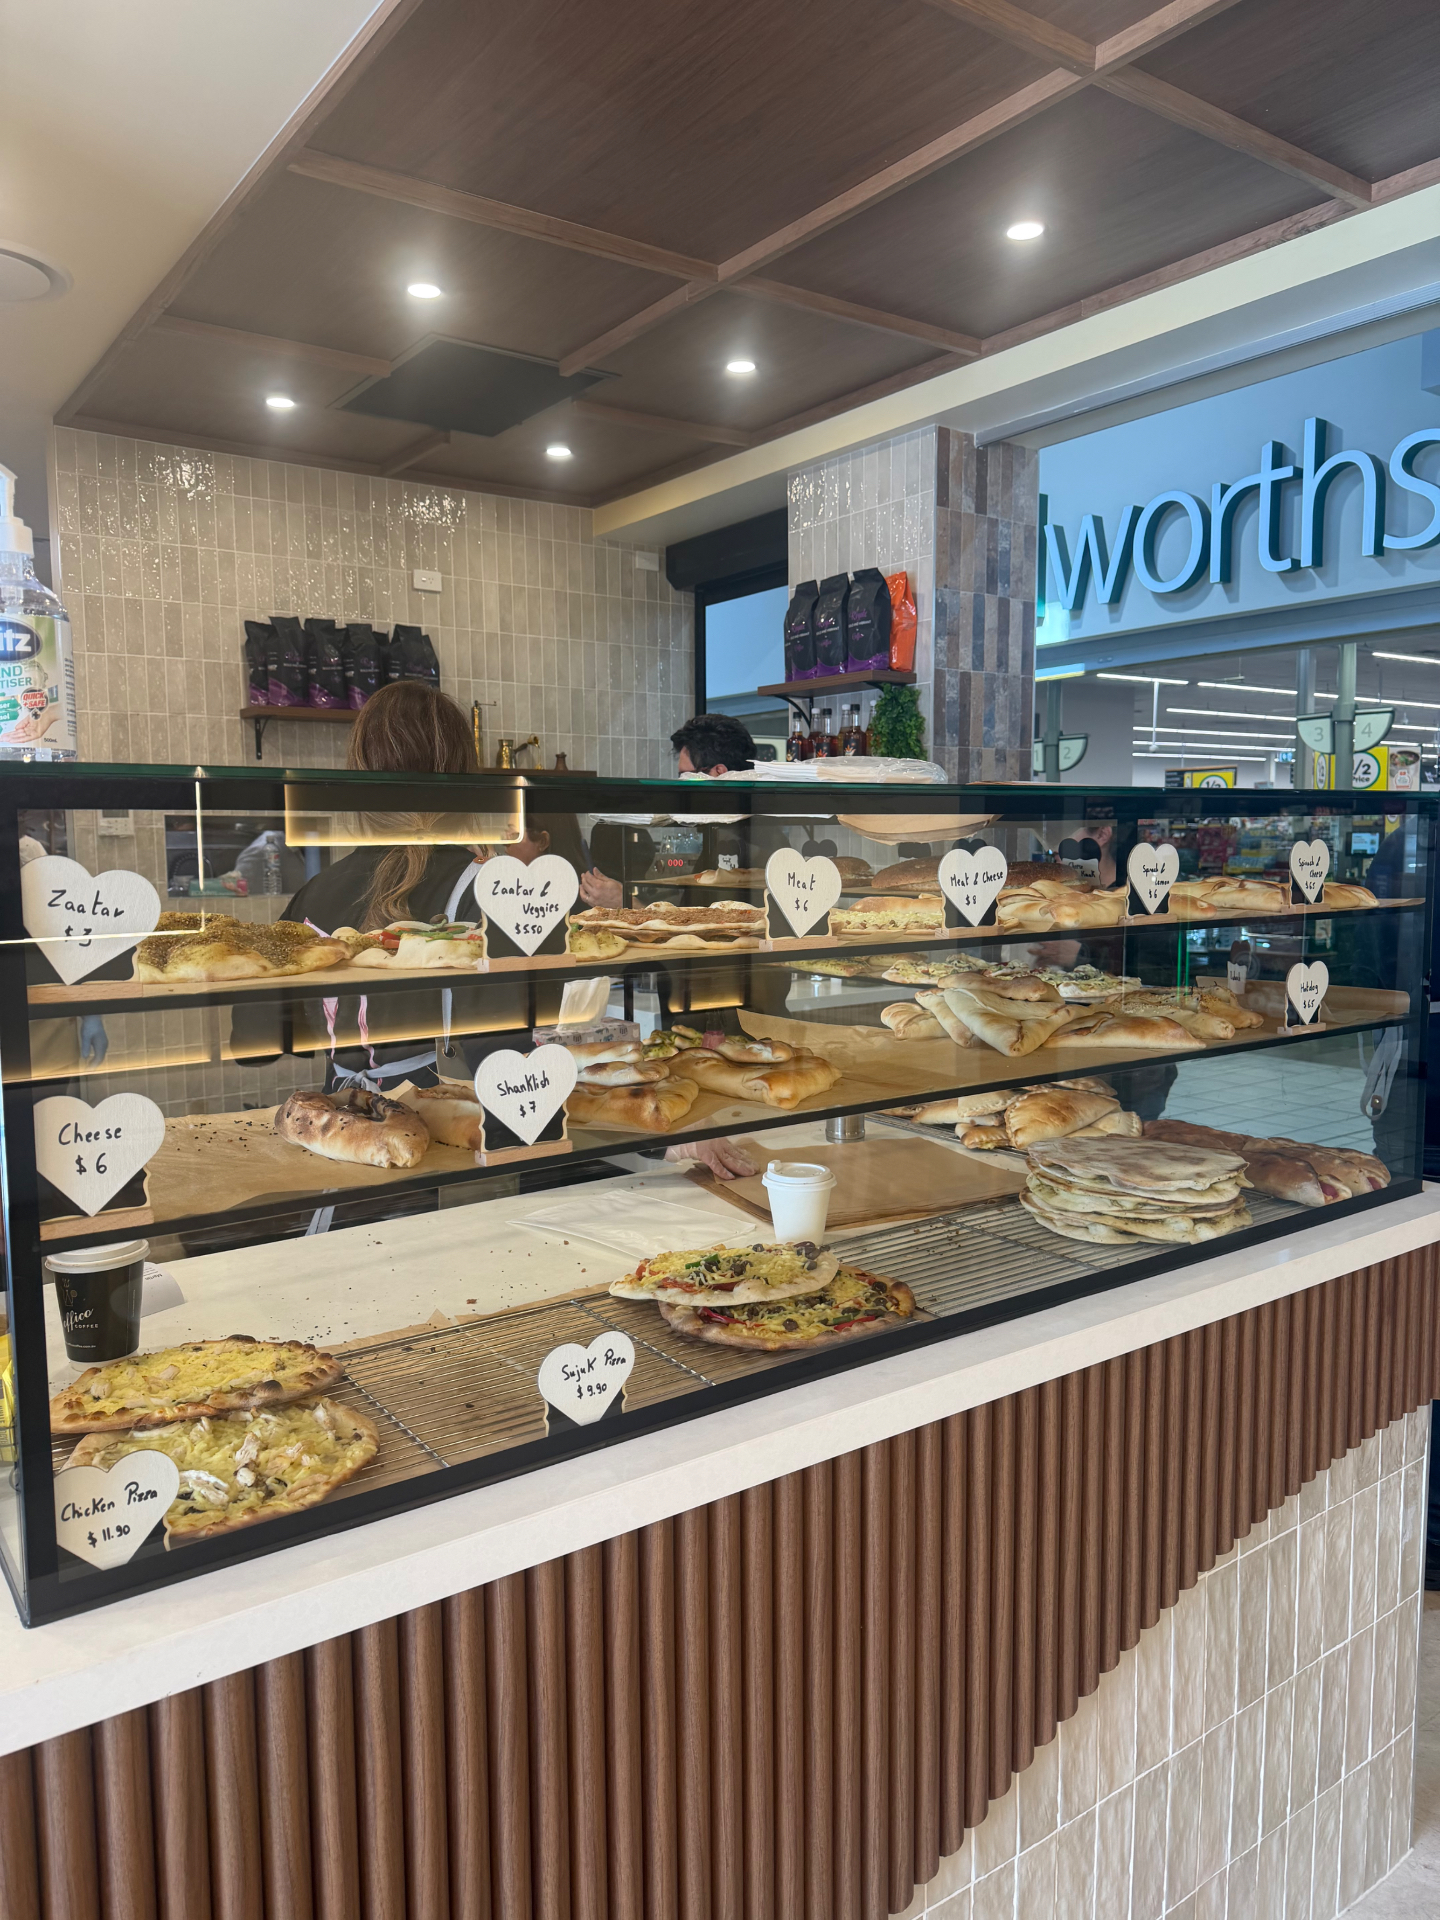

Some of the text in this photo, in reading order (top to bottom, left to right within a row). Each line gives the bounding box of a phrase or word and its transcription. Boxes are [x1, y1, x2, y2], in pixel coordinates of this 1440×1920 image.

[1040, 417, 1440, 619] worths
[1313, 726, 1324, 742] 3
[1361, 722, 1372, 738] 4
[1063, 746, 1071, 760] 2
[1353, 758, 1372, 776] /2
[667, 858, 684, 868] 000
[491, 877, 535, 896] Zaatar
[787, 871, 817, 891] Meat
[950, 870, 1004, 887] Meat & Cheese
[47, 889, 125, 918] Zaatar
[522, 902, 559, 918] Veggies
[58, 1121, 123, 1146] Cheese
[604, 1348, 627, 1367] Pizza
[124, 1481, 158, 1506] Pizza
